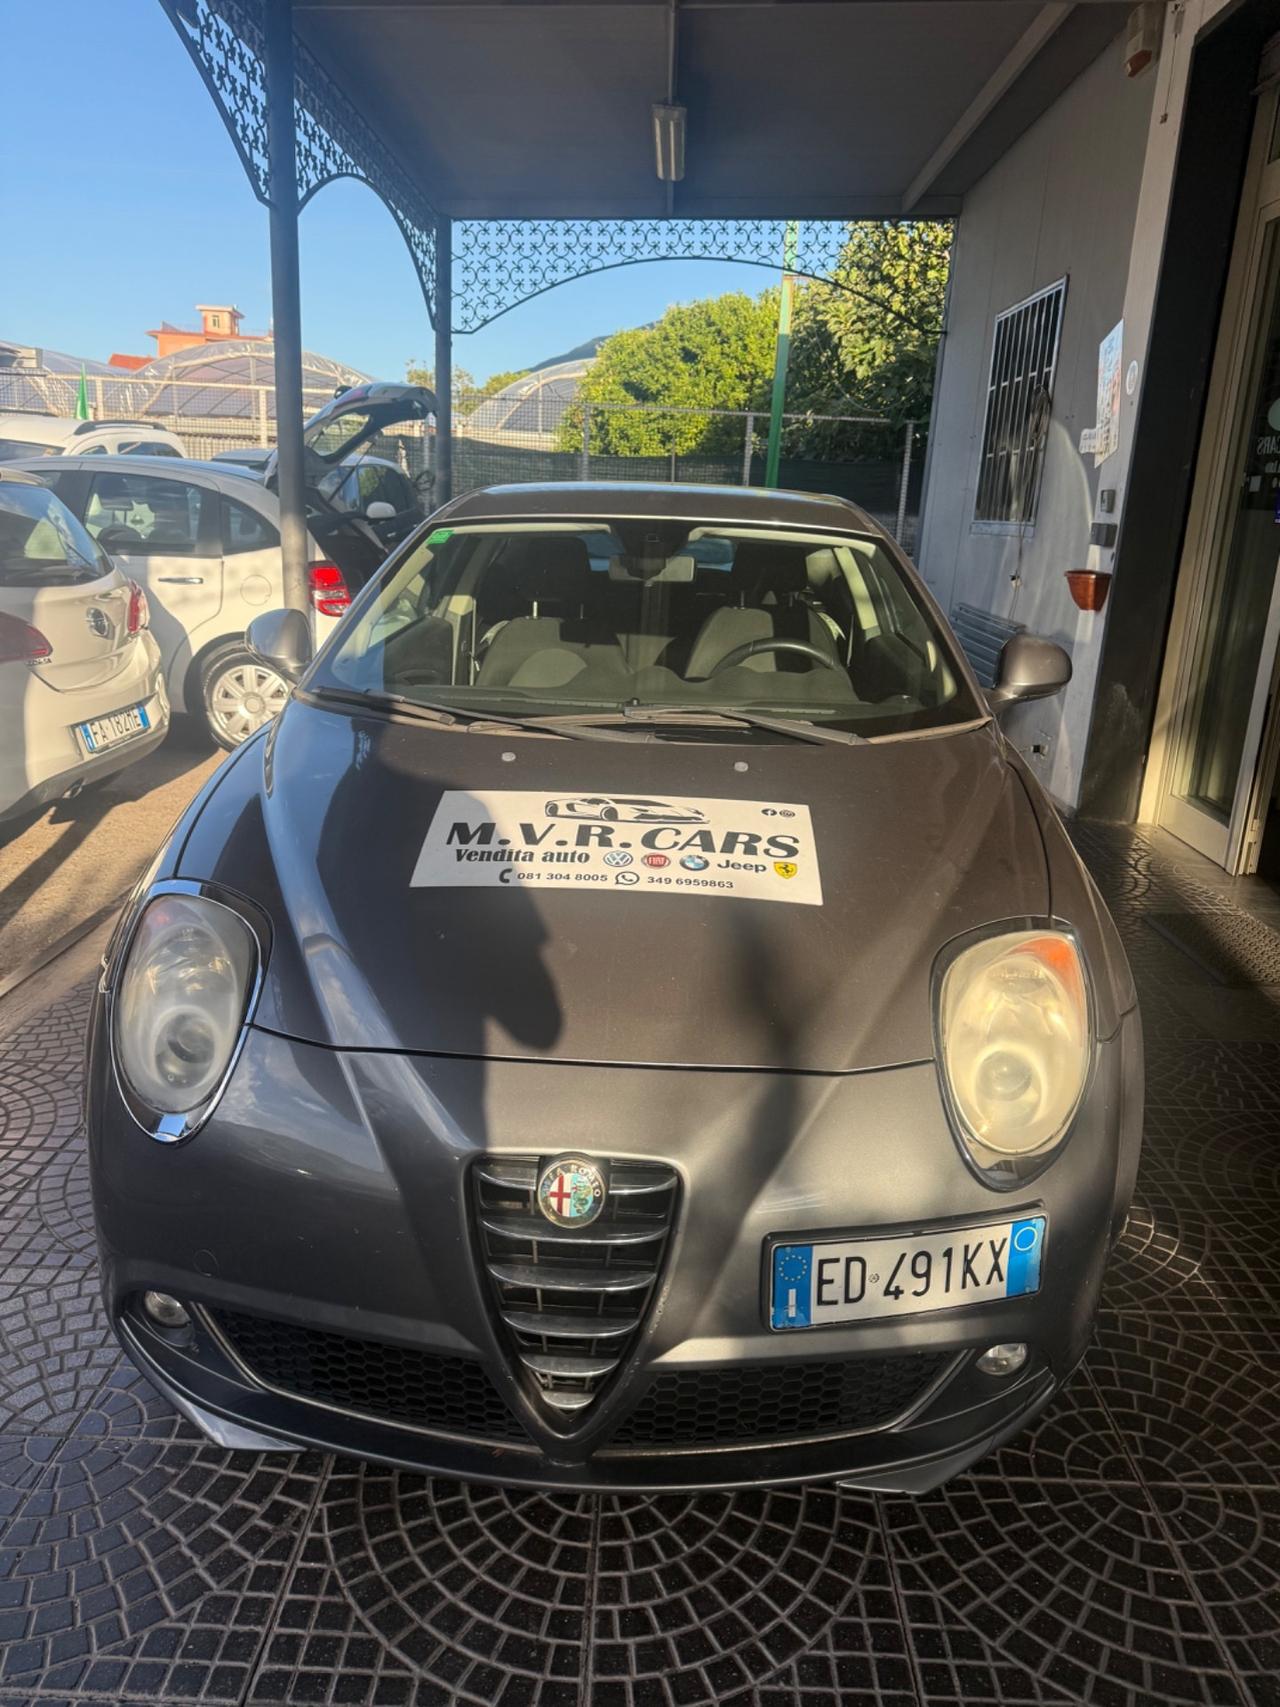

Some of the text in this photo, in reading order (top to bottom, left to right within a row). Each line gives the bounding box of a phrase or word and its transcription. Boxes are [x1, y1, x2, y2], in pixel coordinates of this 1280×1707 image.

[90, 721, 109, 745] FA
[455, 848, 590, 864] Vendita auto
[717, 859, 767, 873] Jeep
[517, 872, 608, 881] 081 304 8005
[647, 876, 734, 889] 349 6959863
[816, 1237, 1008, 1307] ED 491KX
